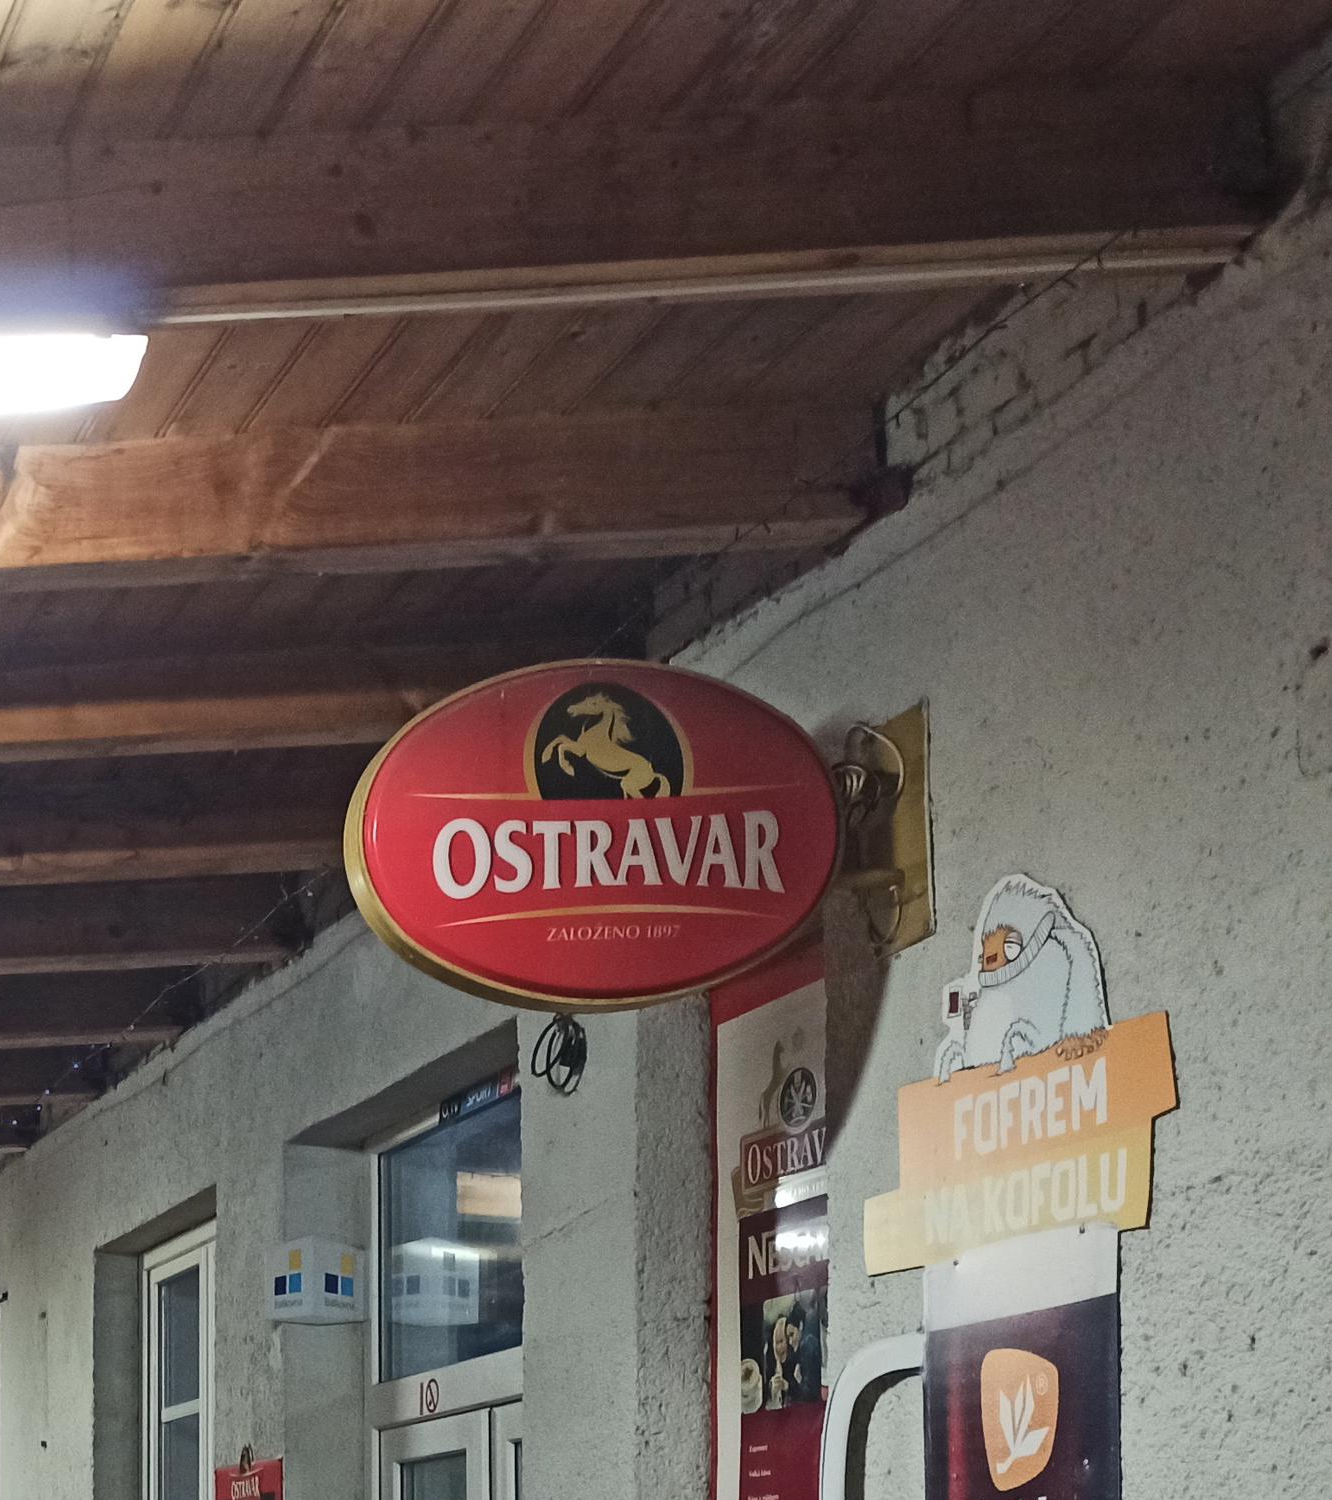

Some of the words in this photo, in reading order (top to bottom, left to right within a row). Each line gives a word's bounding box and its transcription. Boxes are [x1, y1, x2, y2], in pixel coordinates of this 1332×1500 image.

[433, 810, 786, 900] OSTRAVAR
[547, 922, 640, 942] ZALOŽENO
[647, 925, 681, 939] 1897
[954, 1057, 1108, 1161] FOFREM
[923, 1188, 971, 1246] NA
[982, 1147, 1128, 1235] KOFOLU
